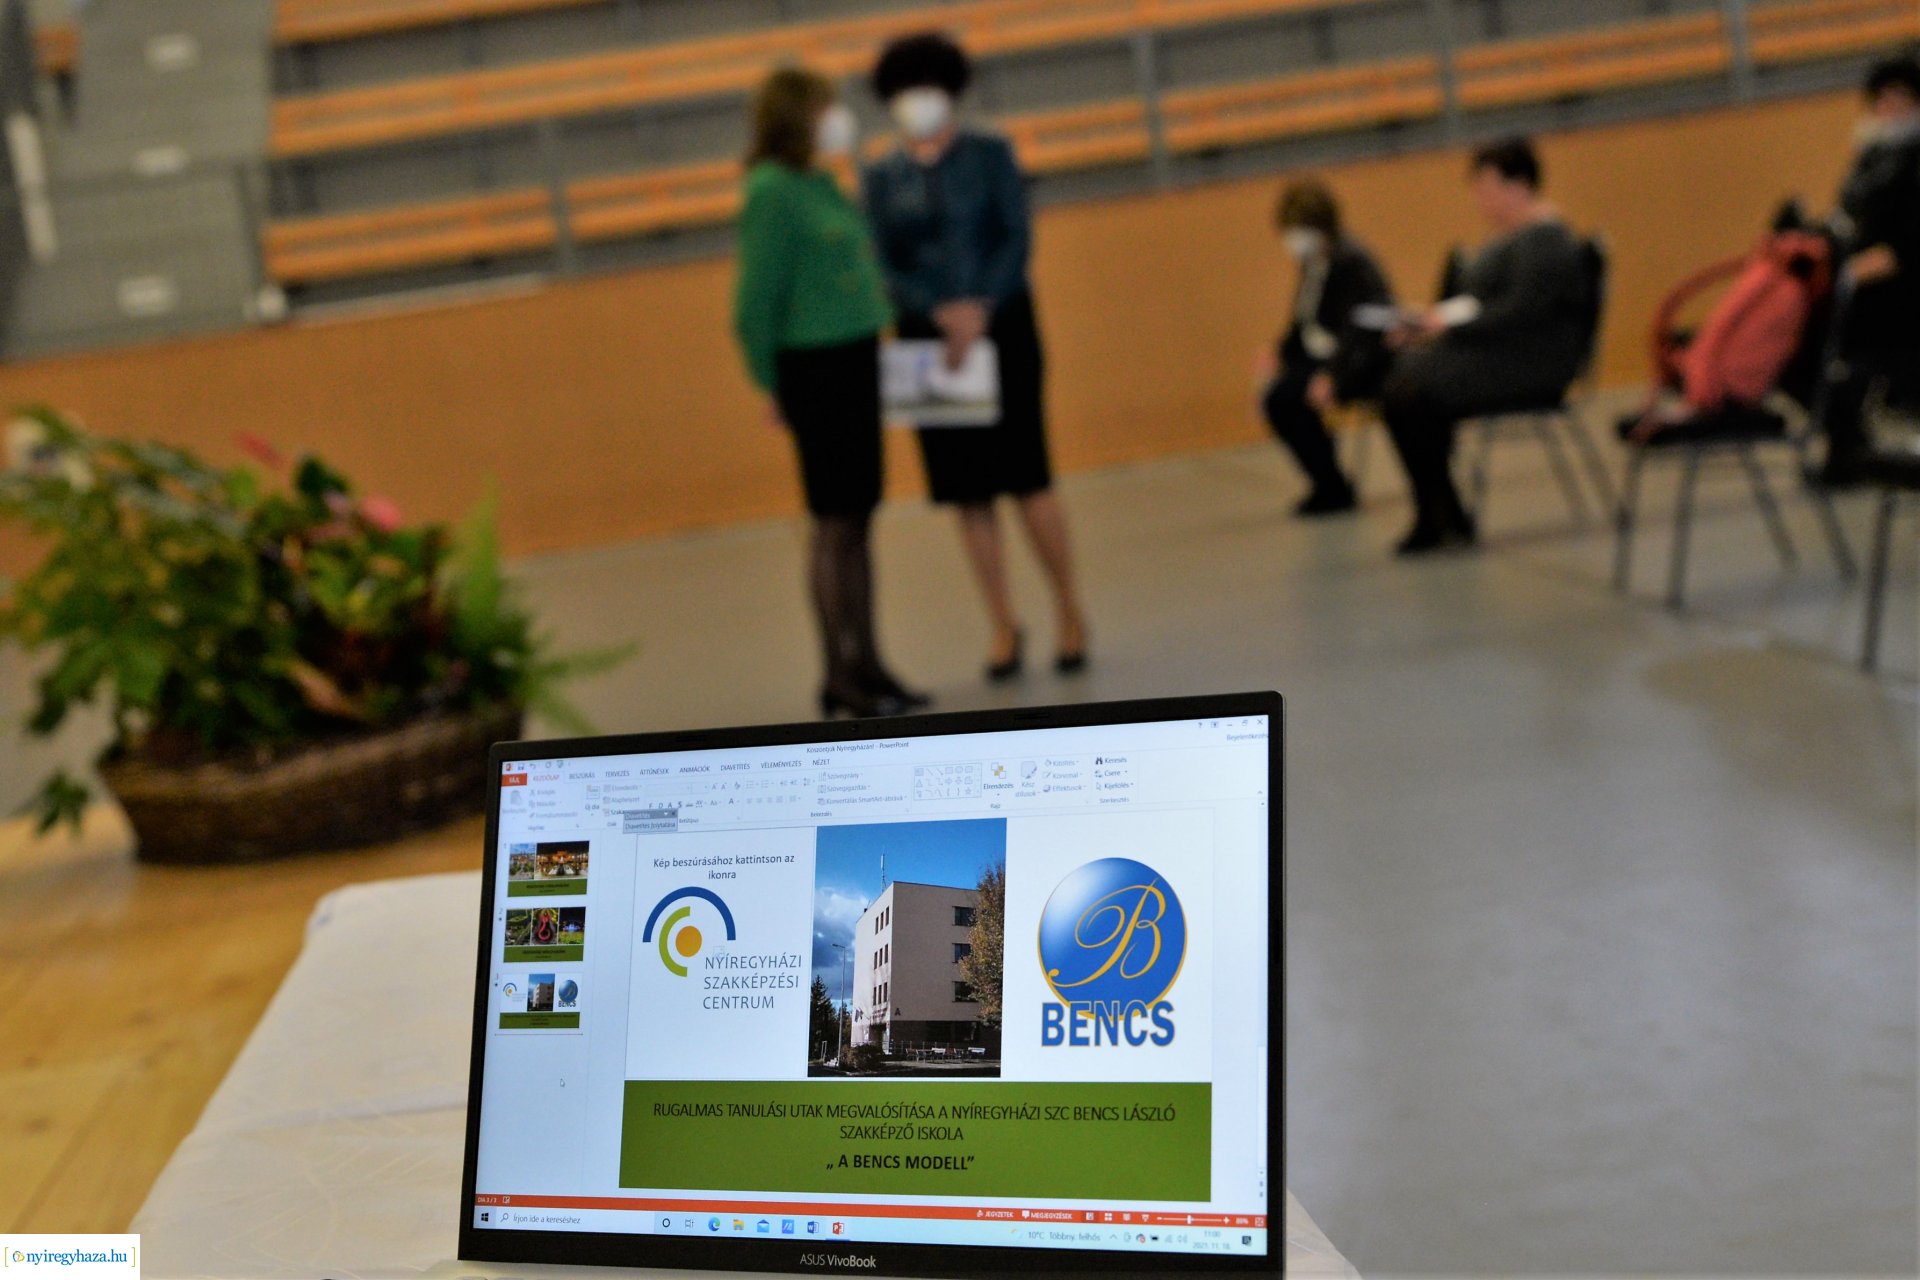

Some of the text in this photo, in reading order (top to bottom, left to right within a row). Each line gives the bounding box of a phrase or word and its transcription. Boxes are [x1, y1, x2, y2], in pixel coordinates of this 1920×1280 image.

[879, 741, 909, 749] PowerPoint
[761, 759, 802, 770] VÉLEMÉNYEZÉS
[812, 758, 830, 767] NÉZET
[605, 769, 630, 777] TERVEZÉS
[653, 853, 795, 870] Kép beszúrásához kattintson az
[707, 870, 737, 880] ikonra
[704, 952, 803, 970] NYÍREGYHÁZI
[703, 972, 800, 990] SZAKKÉPZÉSI
[702, 995, 775, 1010] CENTRUM
[1041, 1000, 1176, 1047] BENCS
[653, 1100, 1176, 1122] RUGALMAS TANULÁSI UTAK MEGVALÓSÍTÁSA A NYÍREGYHÁZI SZC BENCS LÁSZLÓ
[839, 1122, 964, 1141] SZAKKÉPZŐ ISKOLA
[838, 1154, 849, 1168] A
[853, 1154, 900, 1169] BENCS
[513, 1213, 528, 1224] Írjon
[529, 1215, 539, 1223] ide
[546, 1215, 581, 1224] kereséshez
[1028, 1231, 1044, 1239] 10°C
[800, 1253, 877, 1268] ASUS VivoBook
